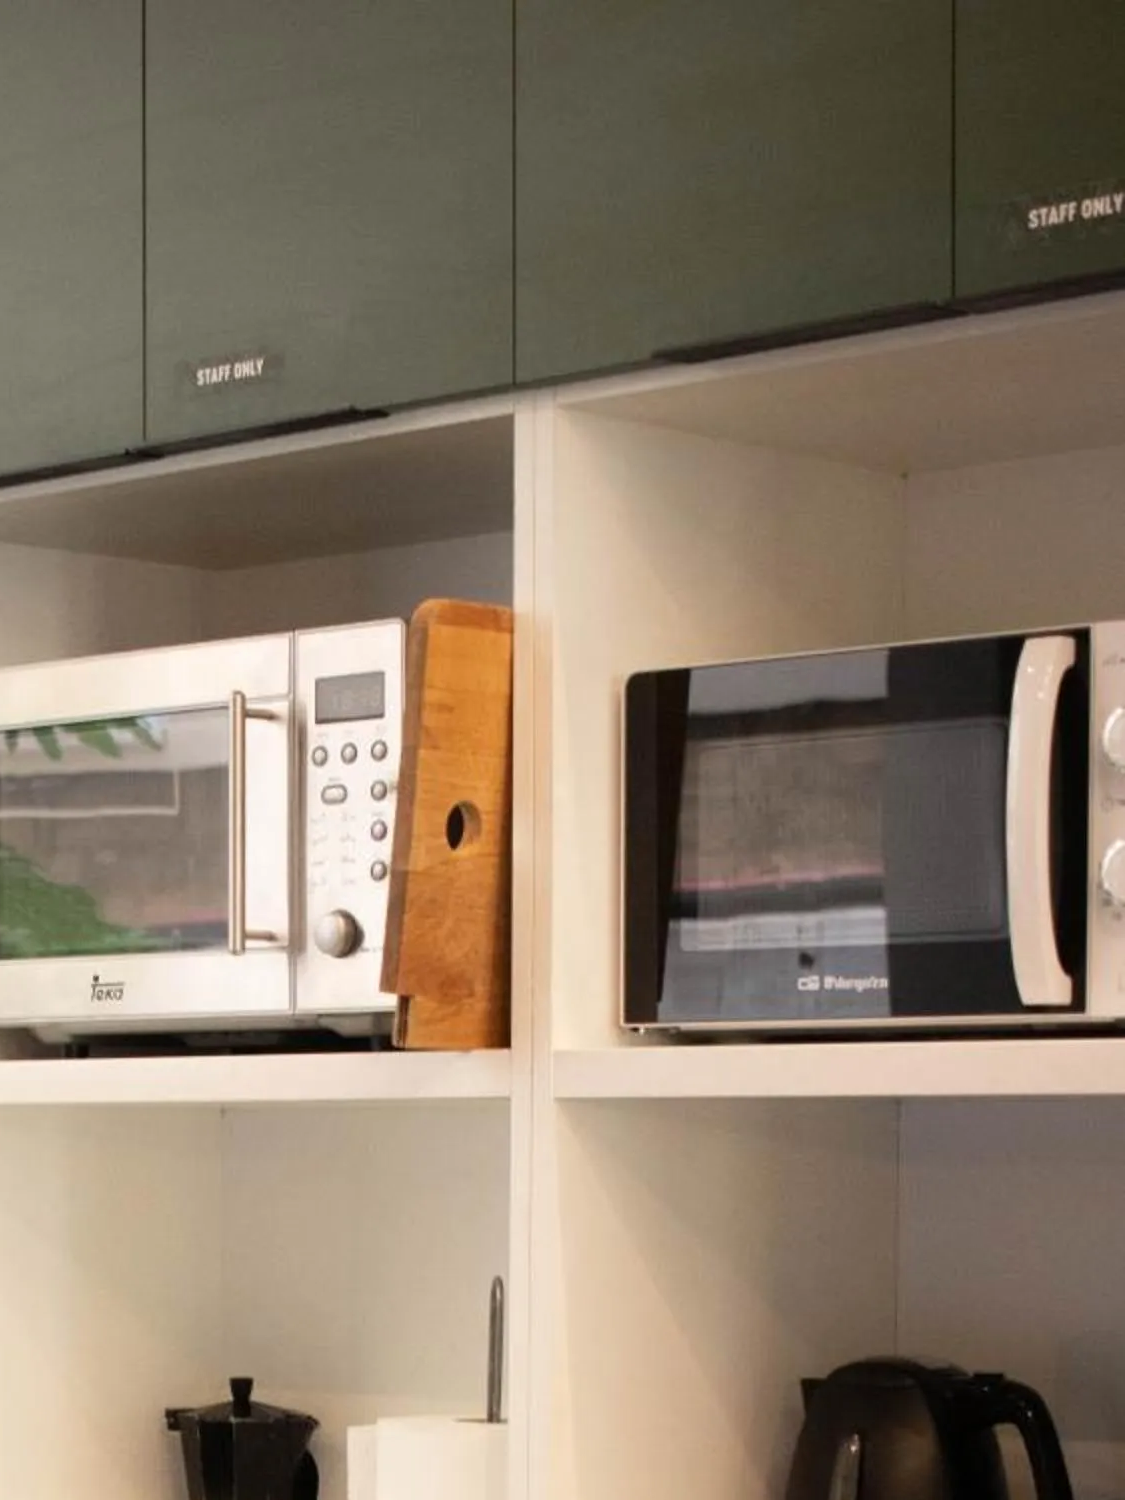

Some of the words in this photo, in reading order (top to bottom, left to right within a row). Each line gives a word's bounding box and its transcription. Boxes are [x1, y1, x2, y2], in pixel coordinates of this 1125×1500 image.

[1027, 201, 1078, 230] STAFF
[1080, 192, 1124, 220] ONLY
[196, 363, 232, 386] STAFF
[234, 357, 265, 379] ONLY
